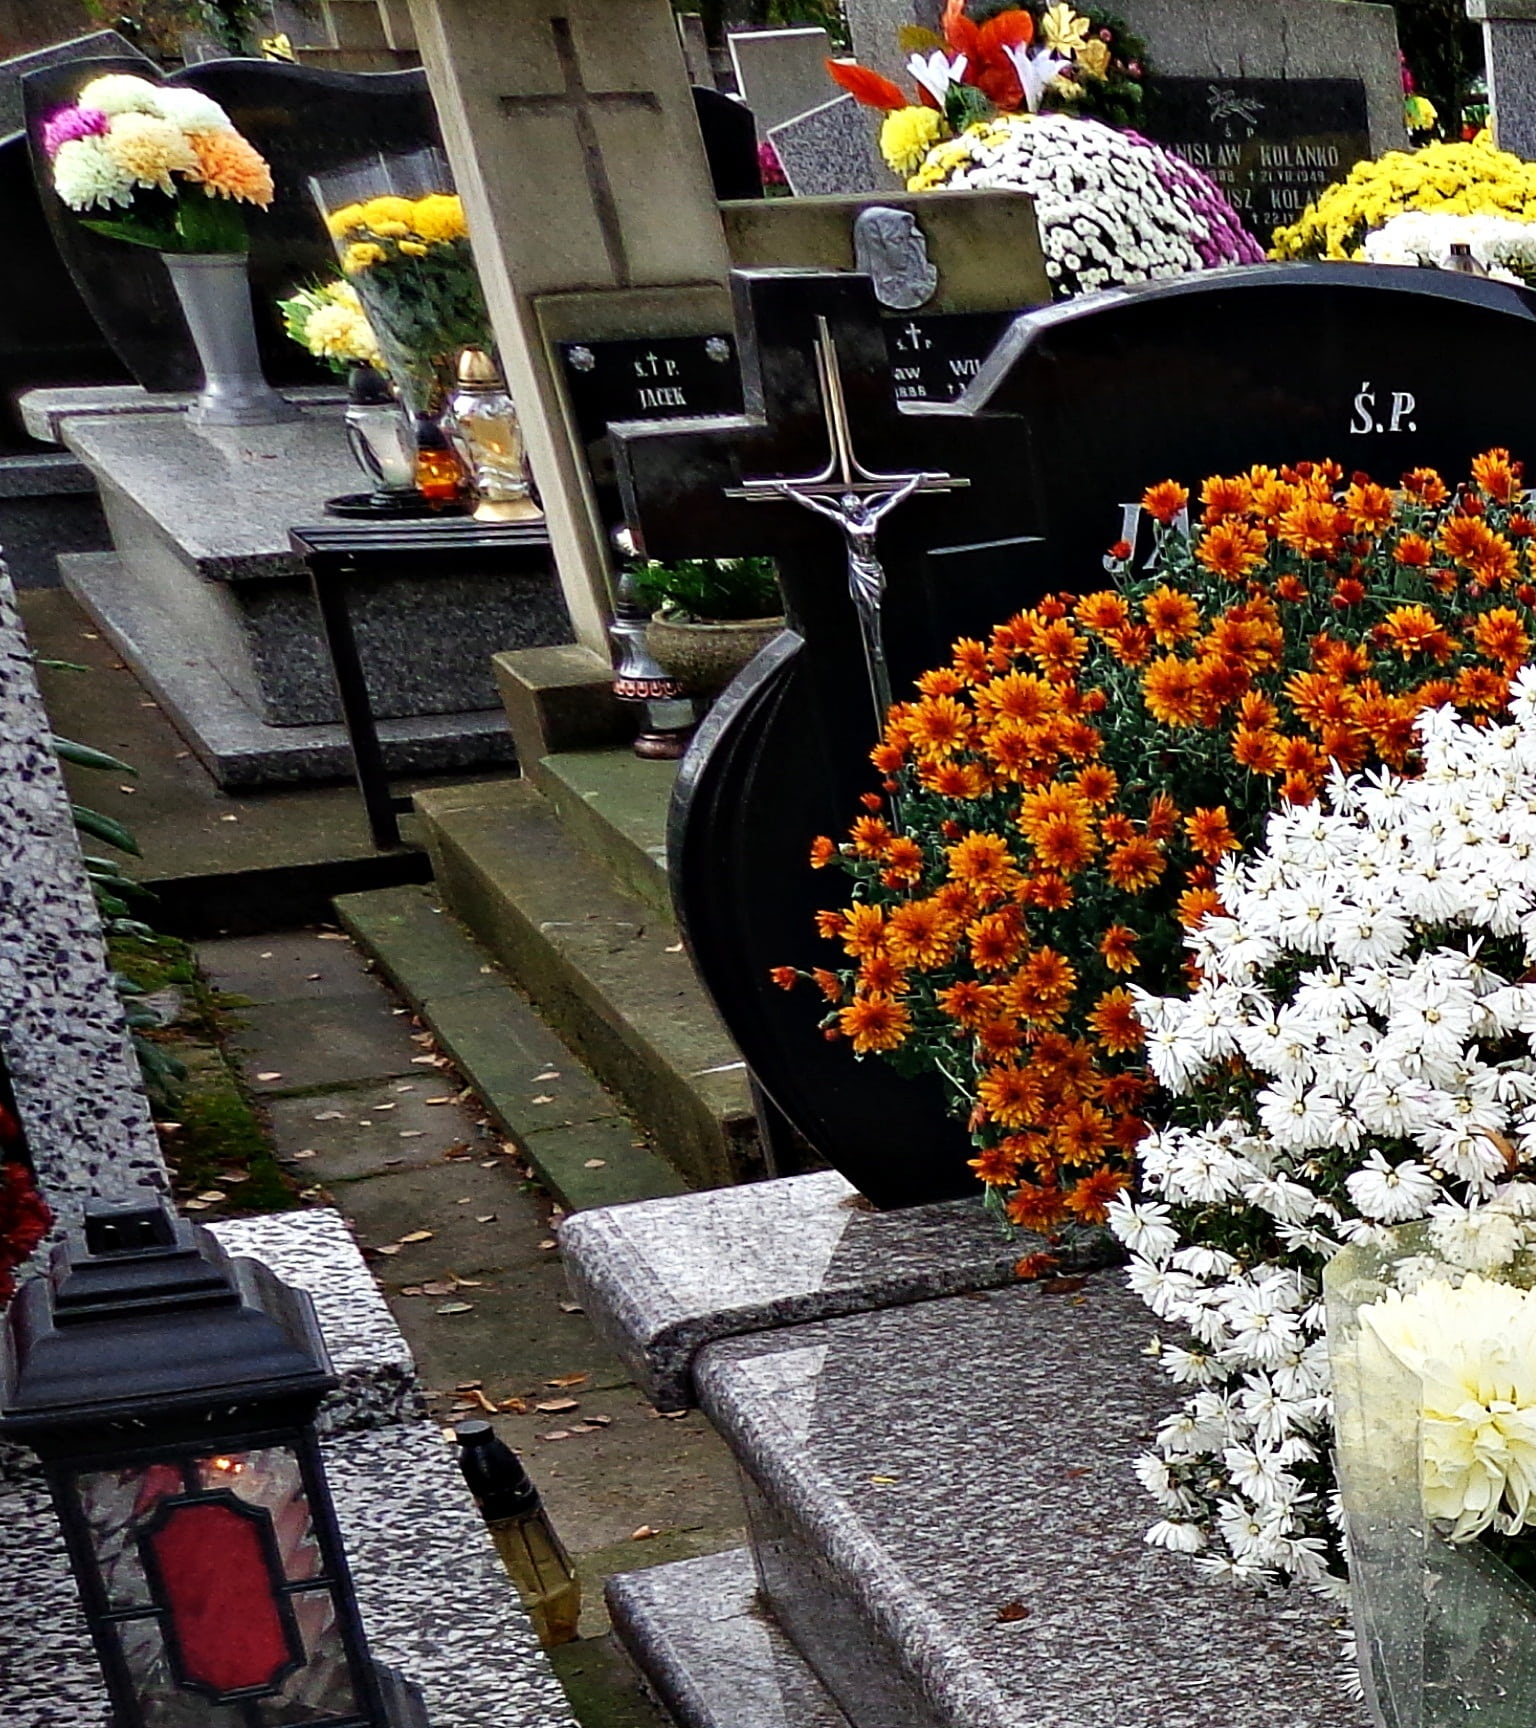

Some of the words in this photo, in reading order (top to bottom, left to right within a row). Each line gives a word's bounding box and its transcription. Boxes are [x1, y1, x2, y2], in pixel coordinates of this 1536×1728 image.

[1261, 145, 1339, 167] KOLANKO
[1270, 188, 1320, 209] KOLA
[638, 387, 686, 410] JACEK
